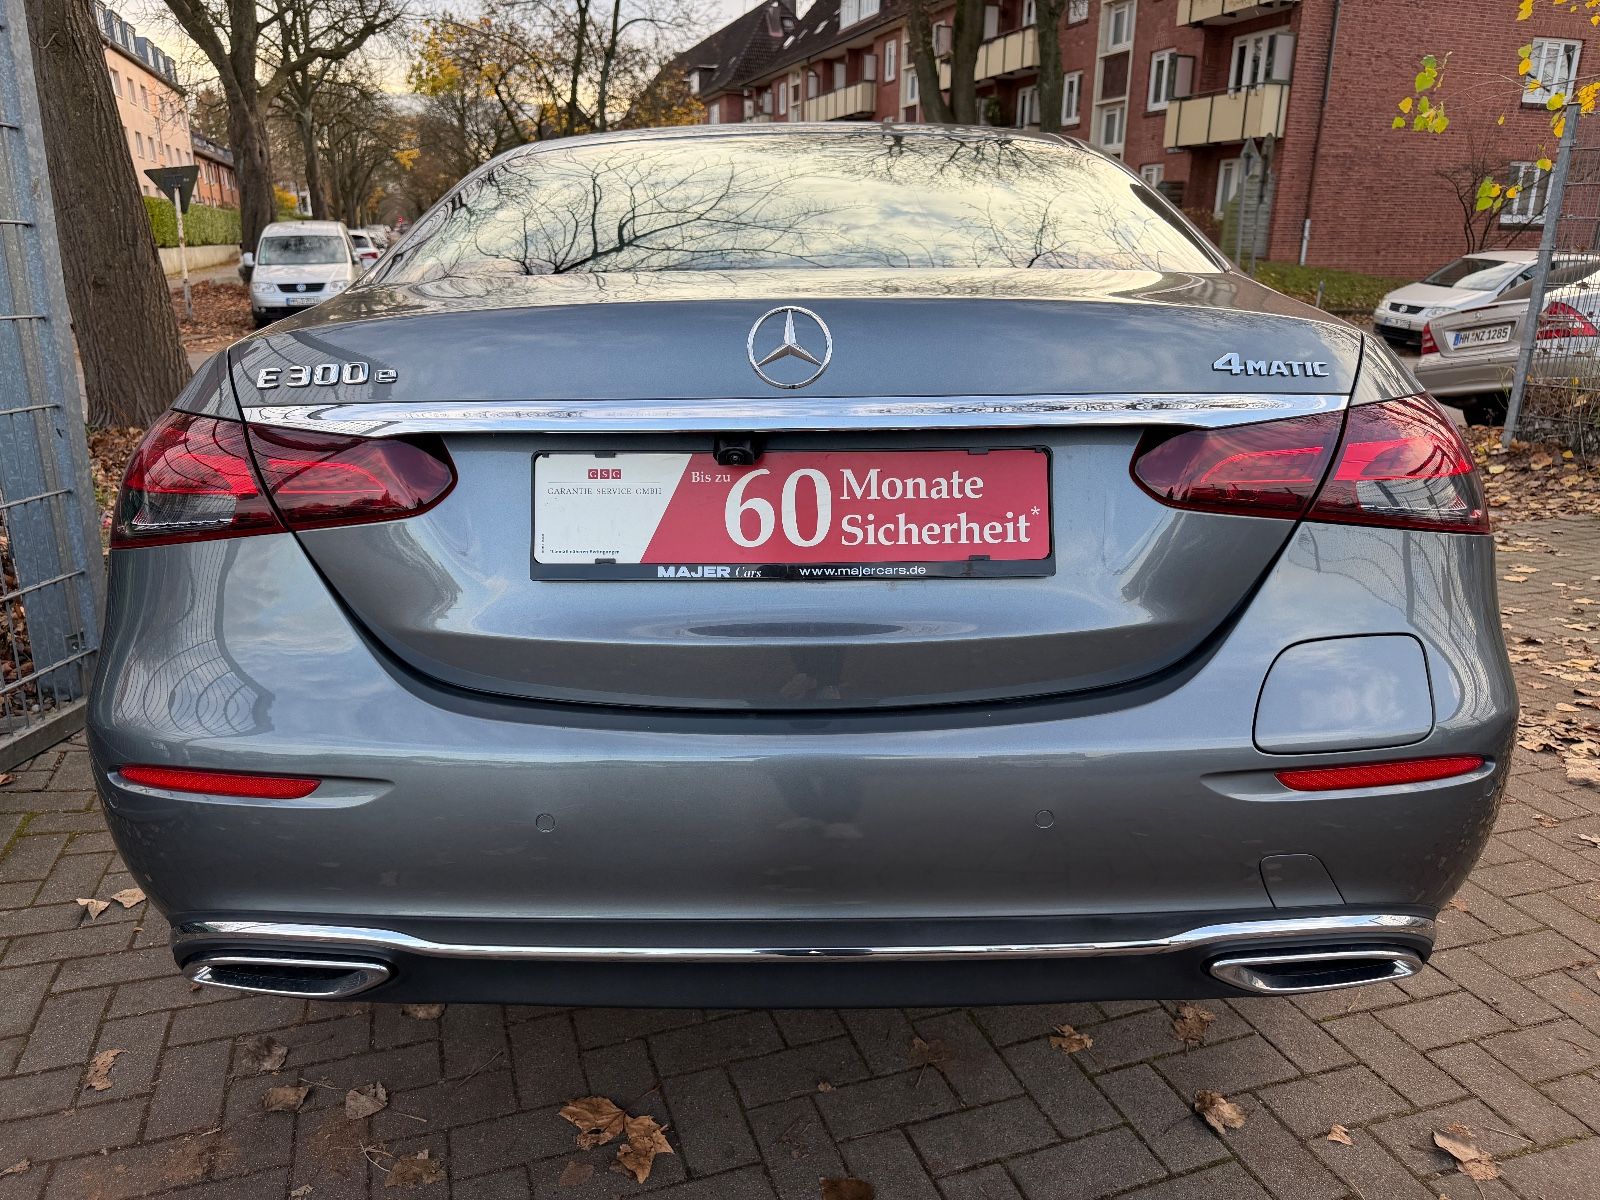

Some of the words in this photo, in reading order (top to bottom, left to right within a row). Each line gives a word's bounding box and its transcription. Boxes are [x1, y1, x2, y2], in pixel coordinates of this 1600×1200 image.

[1212, 352, 1330, 377] 4MATIC
[256, 368, 282, 389] E
[286, 362, 369, 388] 300
[374, 369, 398, 384] e
[588, 469, 622, 480] GSG
[691, 471, 712, 483] Bis
[715, 473, 731, 483] zu
[840, 468, 984, 500] Monate
[547, 487, 593, 496] GARANTIE
[596, 487, 632, 496] SERVICE
[724, 468, 832, 548] 60
[657, 565, 731, 578] MAJER
[735, 566, 762, 578] Cars
[799, 566, 927, 577] www.majercars.de
